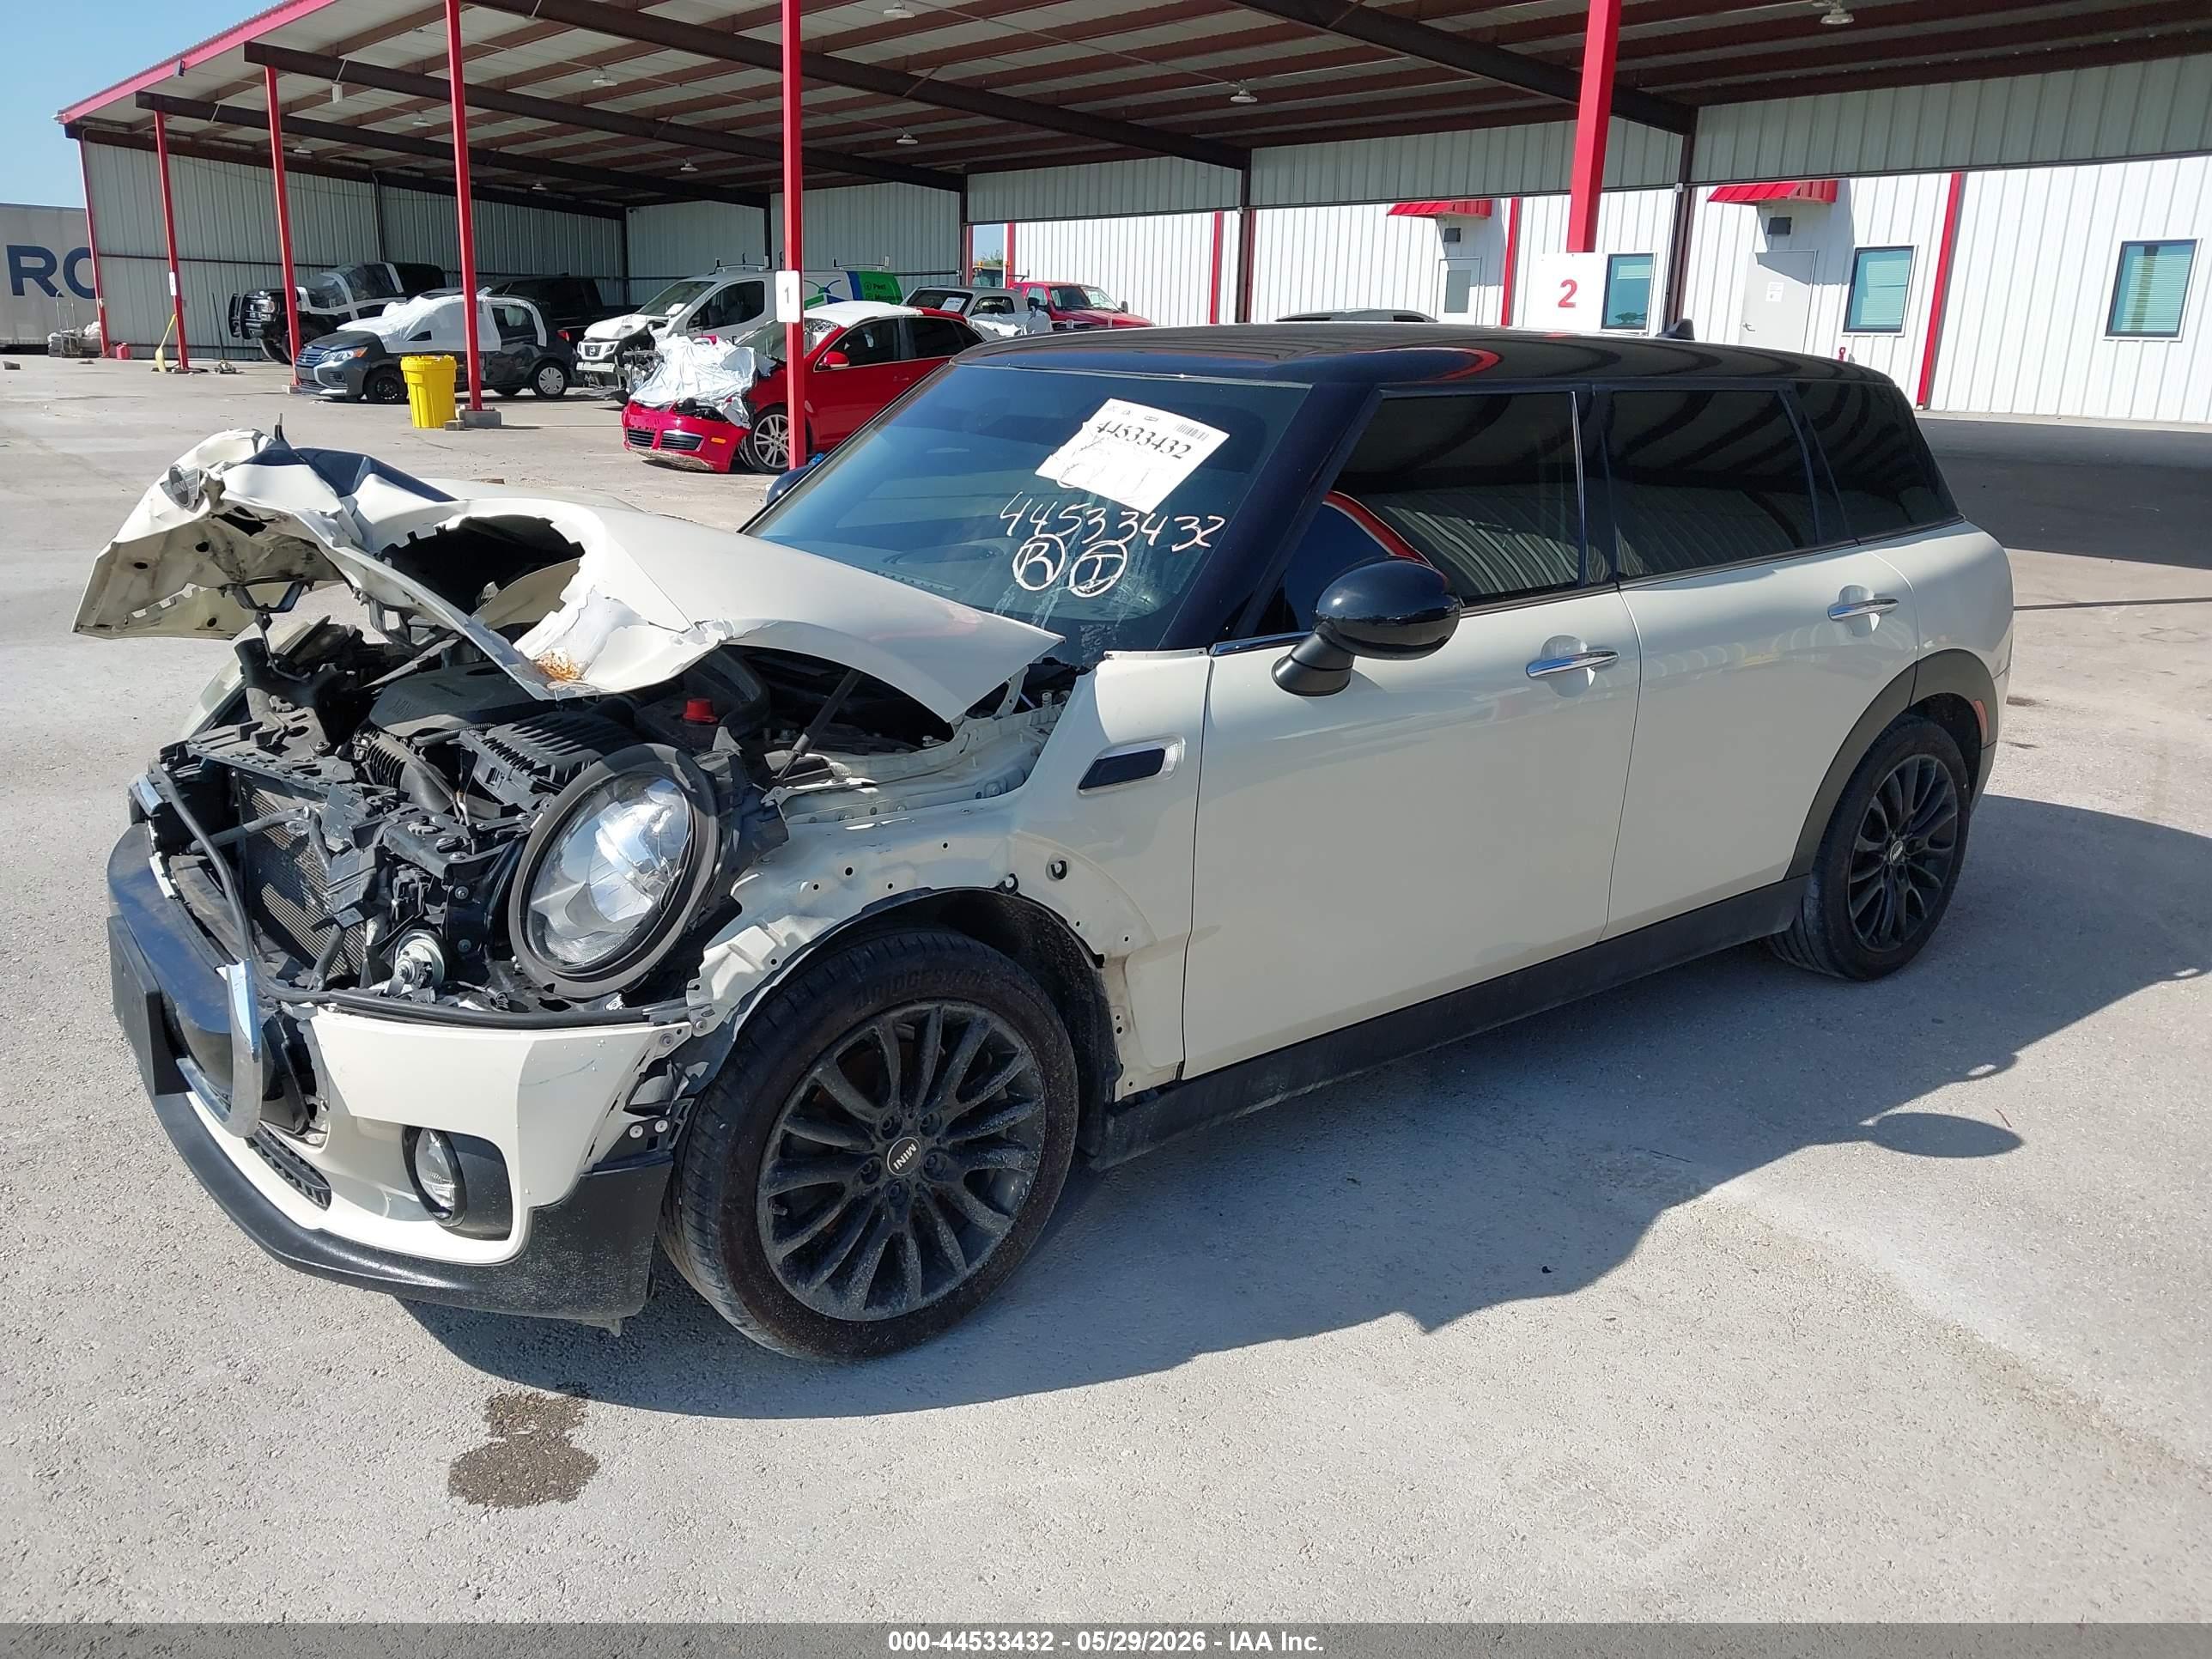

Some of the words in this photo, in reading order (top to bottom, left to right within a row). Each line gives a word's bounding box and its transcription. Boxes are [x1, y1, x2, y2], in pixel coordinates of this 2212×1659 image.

[784, 286, 790, 304] 1
[1558, 279, 1578, 308] 2
[1097, 420, 1192, 459] 44533432
[1000, 491, 1226, 553] 44533432
[893, 1143, 917, 1170] MINI
